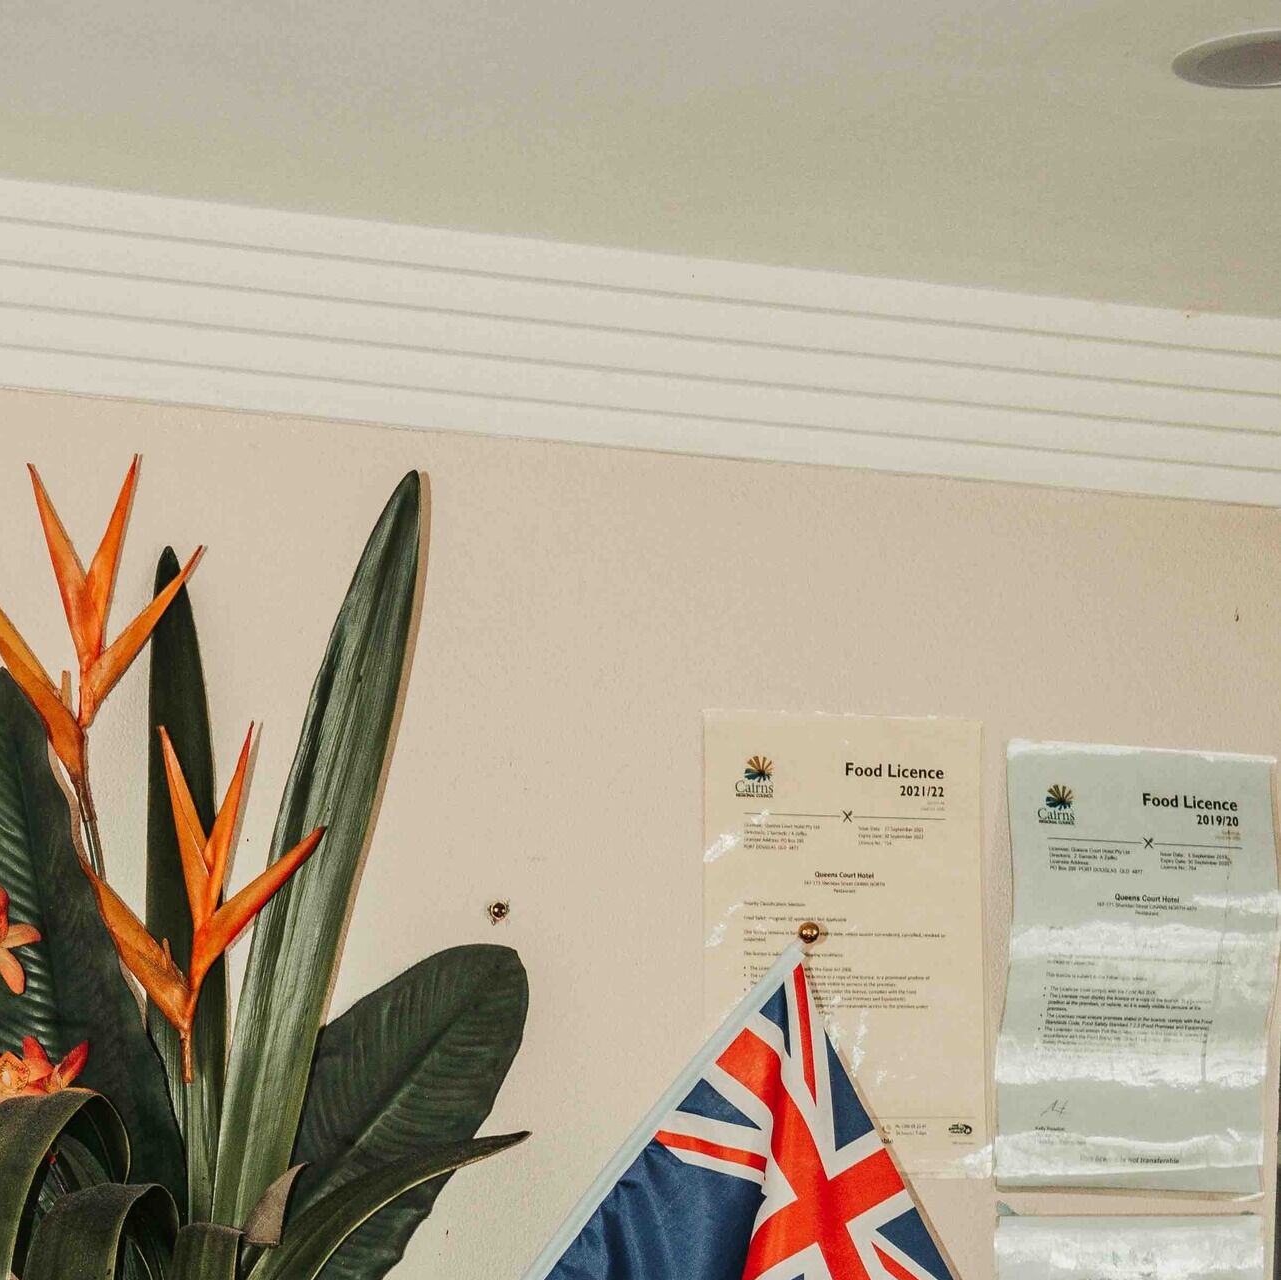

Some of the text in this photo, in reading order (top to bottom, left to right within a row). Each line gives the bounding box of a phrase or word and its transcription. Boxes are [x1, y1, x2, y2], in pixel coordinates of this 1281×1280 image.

[845, 762, 944, 779] Food Licence
[735, 780, 774, 794] Cairns
[899, 785, 945, 797] 2021/22
[1142, 793, 1238, 811] Food Licence
[1037, 808, 1075, 820] Cairns
[1196, 814, 1239, 827] 2019/20
[814, 871, 838, 879] Queens
[1114, 893, 1180, 903] Queens Court Hotel
